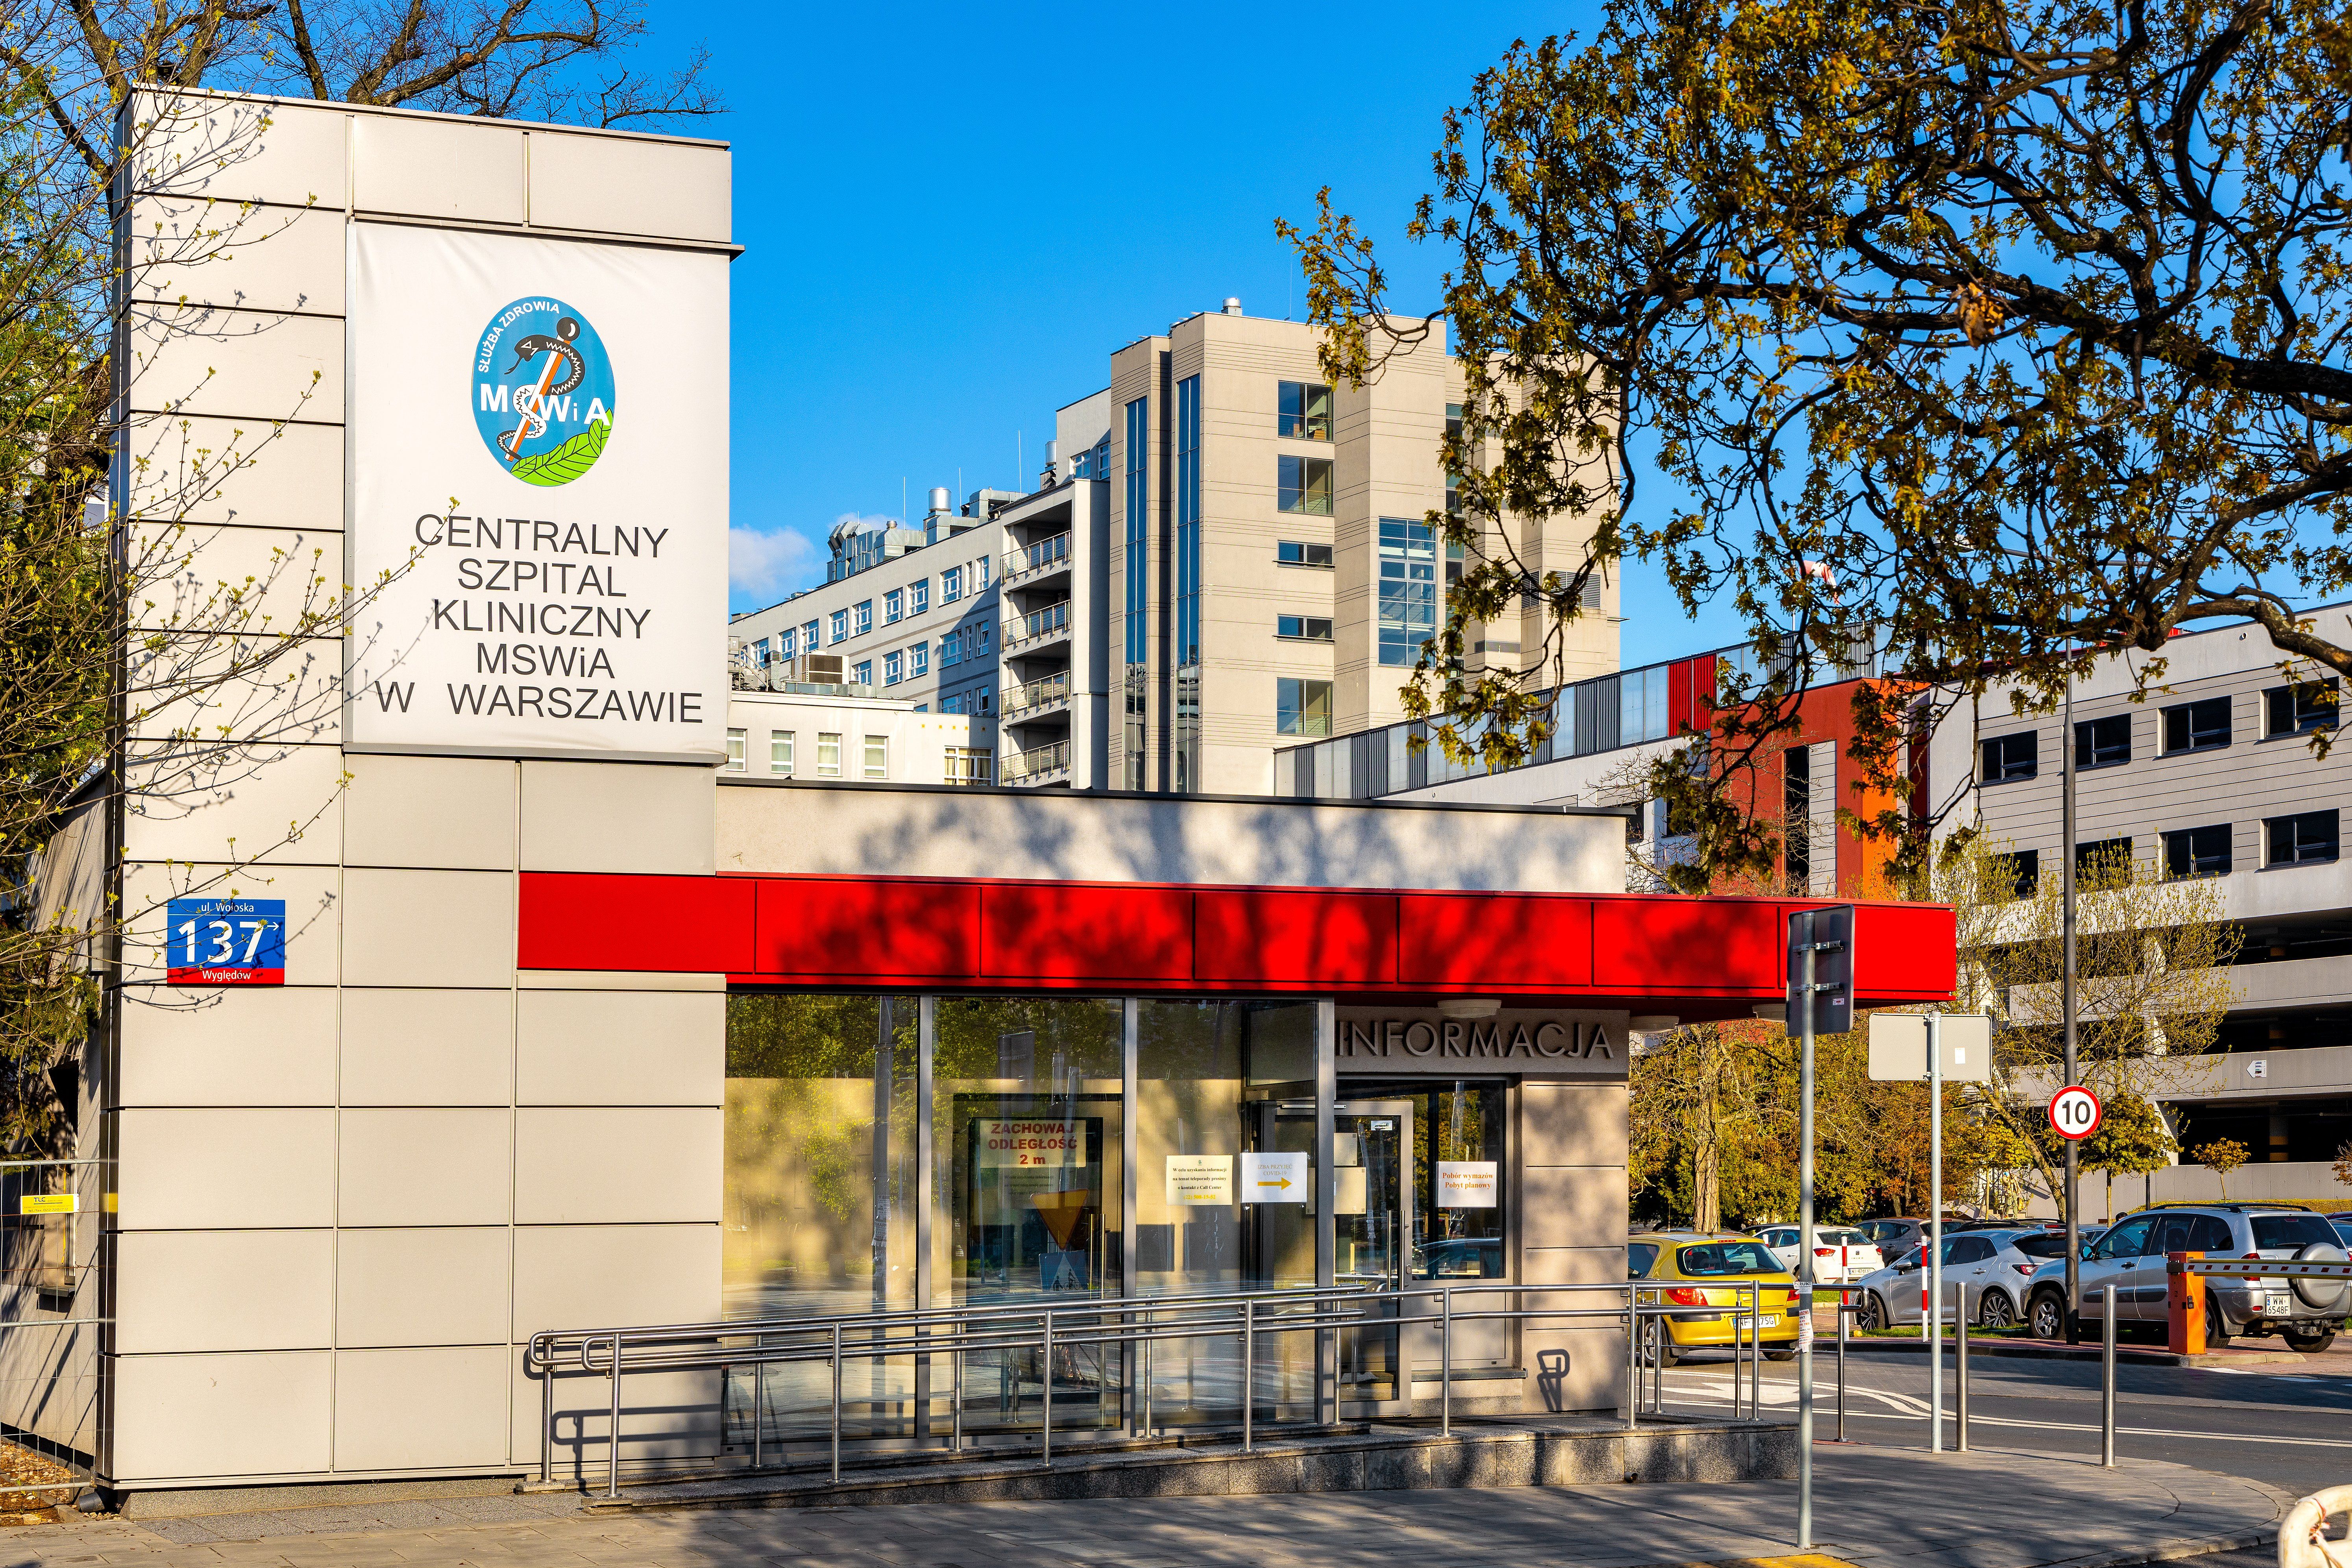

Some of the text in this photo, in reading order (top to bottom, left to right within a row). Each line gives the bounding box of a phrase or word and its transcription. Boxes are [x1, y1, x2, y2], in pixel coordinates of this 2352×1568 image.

[478, 301, 560, 373] SŁUŻBA ZDROWIA
[415, 514, 668, 558] CENTRALNY
[458, 558, 626, 597] SZPITAL
[435, 599, 651, 639] KLINICZNY
[477, 643, 614, 679] MSWiA
[375, 681, 703, 724] W WARSZAWIE
[201, 902, 254, 912] ul. Wołoska
[178, 921, 264, 963] 137
[202, 970, 251, 982] Wyględów
[1336, 1021, 1614, 1059] INFORMACJA
[991, 1123, 1074, 1134] ZACHOWAJ
[2062, 1100, 2090, 1124] 10
[989, 1136, 1077, 1150] ODLEGŁOŚĆ
[1020, 1154, 1046, 1165] 2 m
[2268, 1306, 2289, 1315] 6548F
